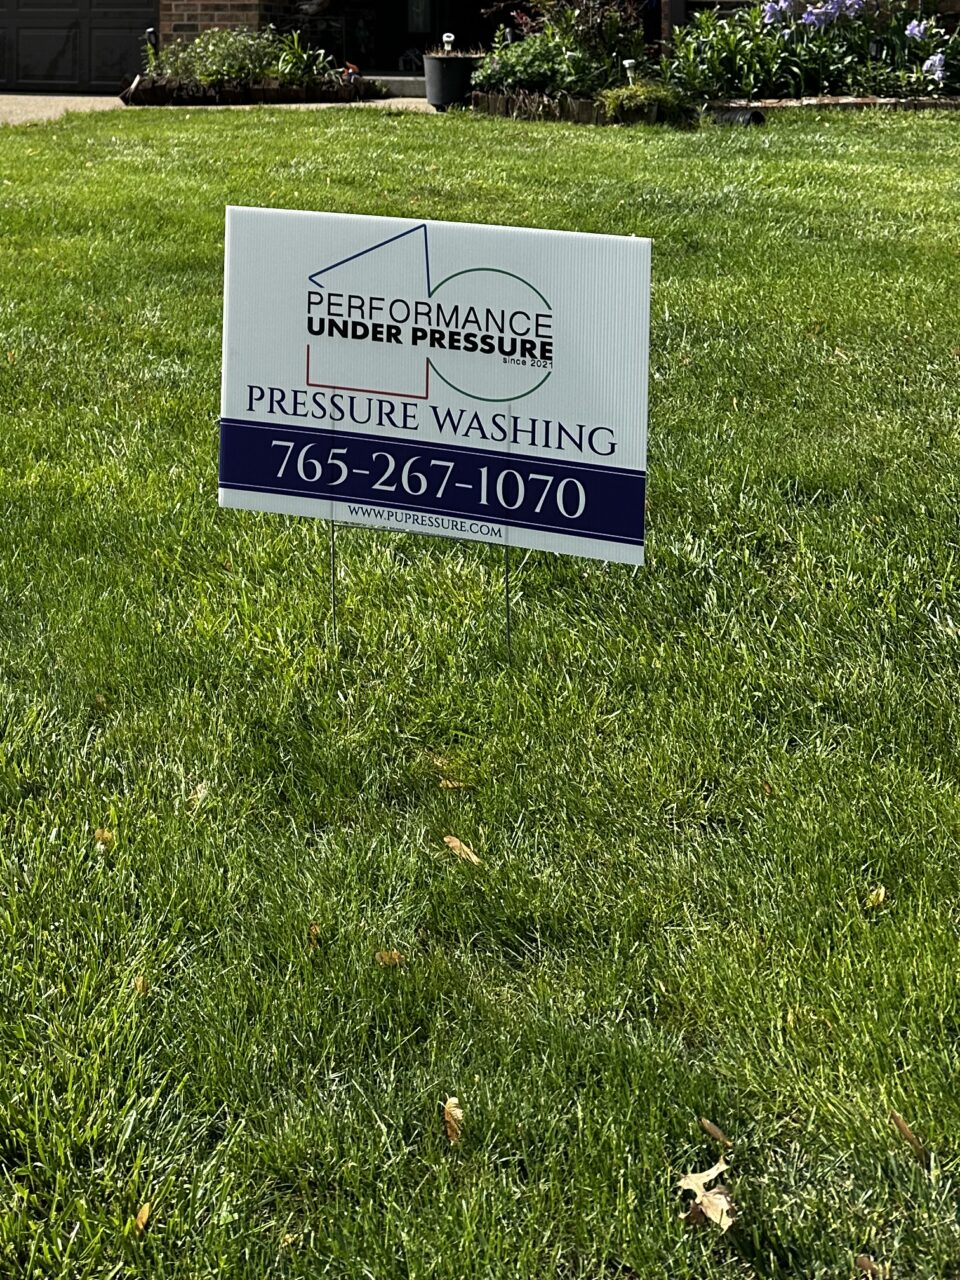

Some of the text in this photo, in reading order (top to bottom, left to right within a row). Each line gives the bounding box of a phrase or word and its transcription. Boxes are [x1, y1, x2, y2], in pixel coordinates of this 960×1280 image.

[307, 290, 553, 339] PERFORMANCE
[307, 316, 553, 361] UNDER PRESSURE
[502, 357, 553, 369] since 2021
[246, 385, 618, 457] PRESSURE WASHING
[270, 440, 587, 519] 765-267-1070
[348, 505, 503, 538] WWW.PUPRESSURE.COM
